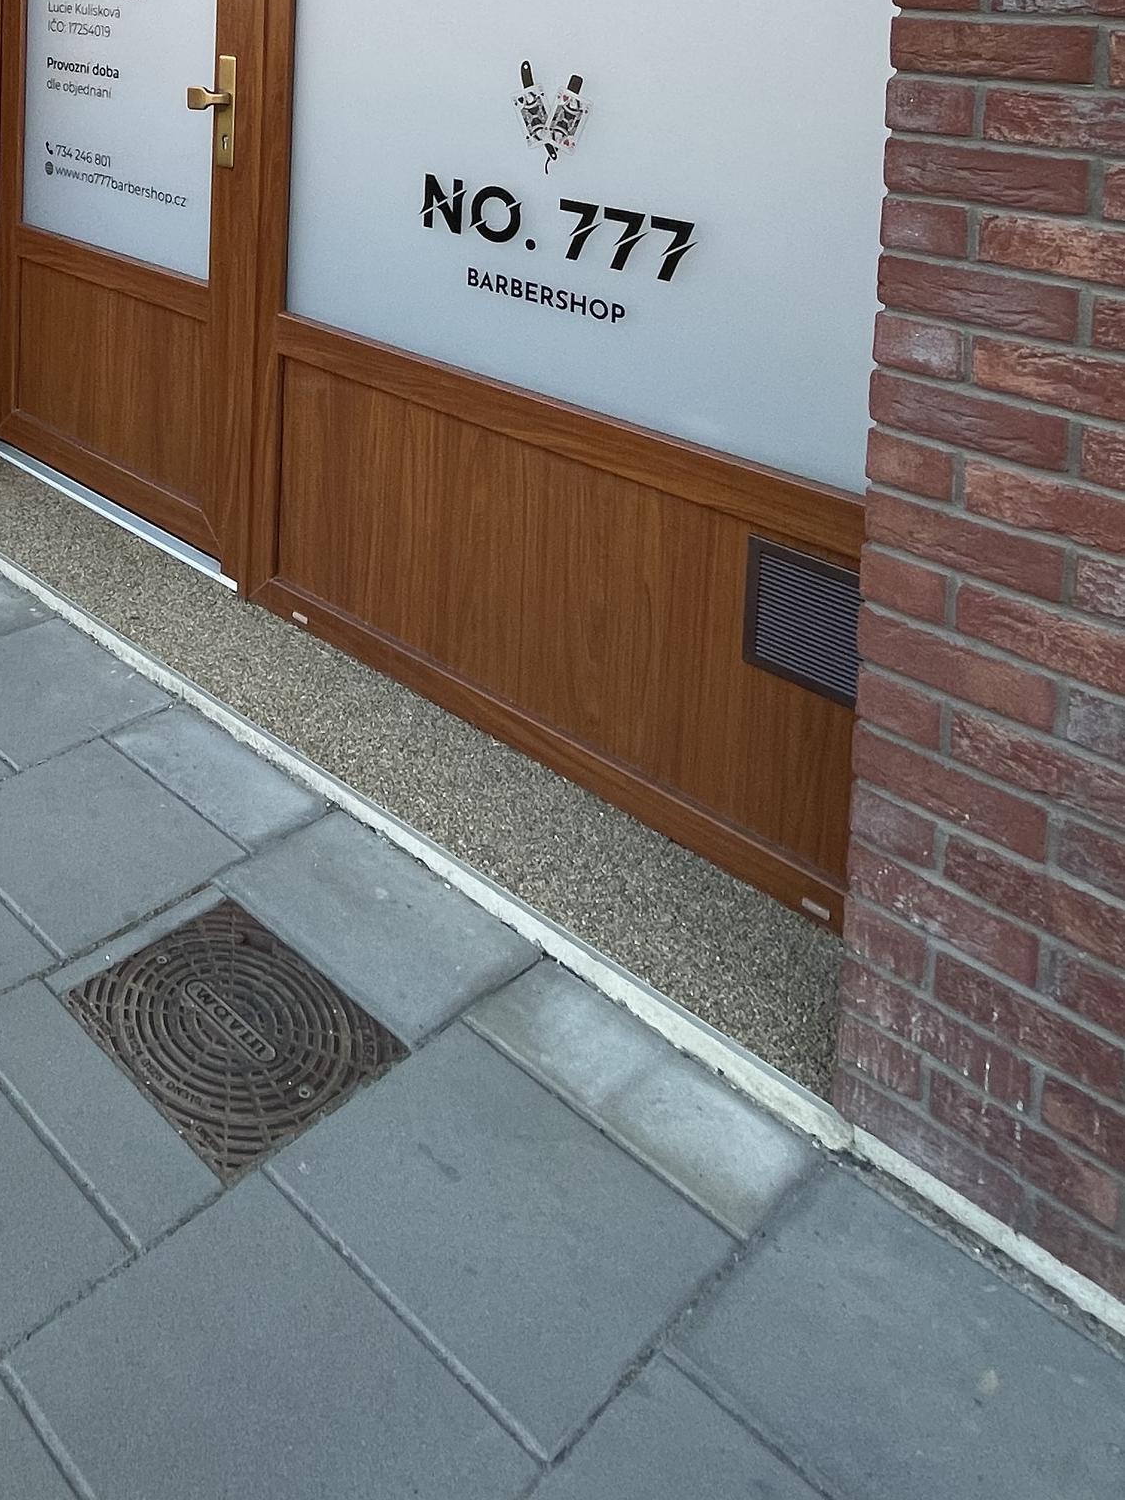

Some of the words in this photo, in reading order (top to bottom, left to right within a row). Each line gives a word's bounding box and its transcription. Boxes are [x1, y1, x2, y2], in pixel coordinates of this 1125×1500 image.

[48, 1, 73, 14] Lucie
[47, 19, 67, 33] IČO:
[68, 22, 111, 37] 17254019
[46, 56, 90, 74] Provozní
[92, 63, 120, 79] doba
[46, 78, 61, 91] dle
[63, 80, 112, 98] objednání
[55, 144, 73, 158] 734
[75, 148, 92, 164] 246
[94, 153, 111, 168] 801
[55, 166, 187, 208] www.no777barbershop.cz
[419, 173, 537, 252] NO.
[559, 197, 698, 282] 777
[467, 266, 626, 324] BARBERSHOP
